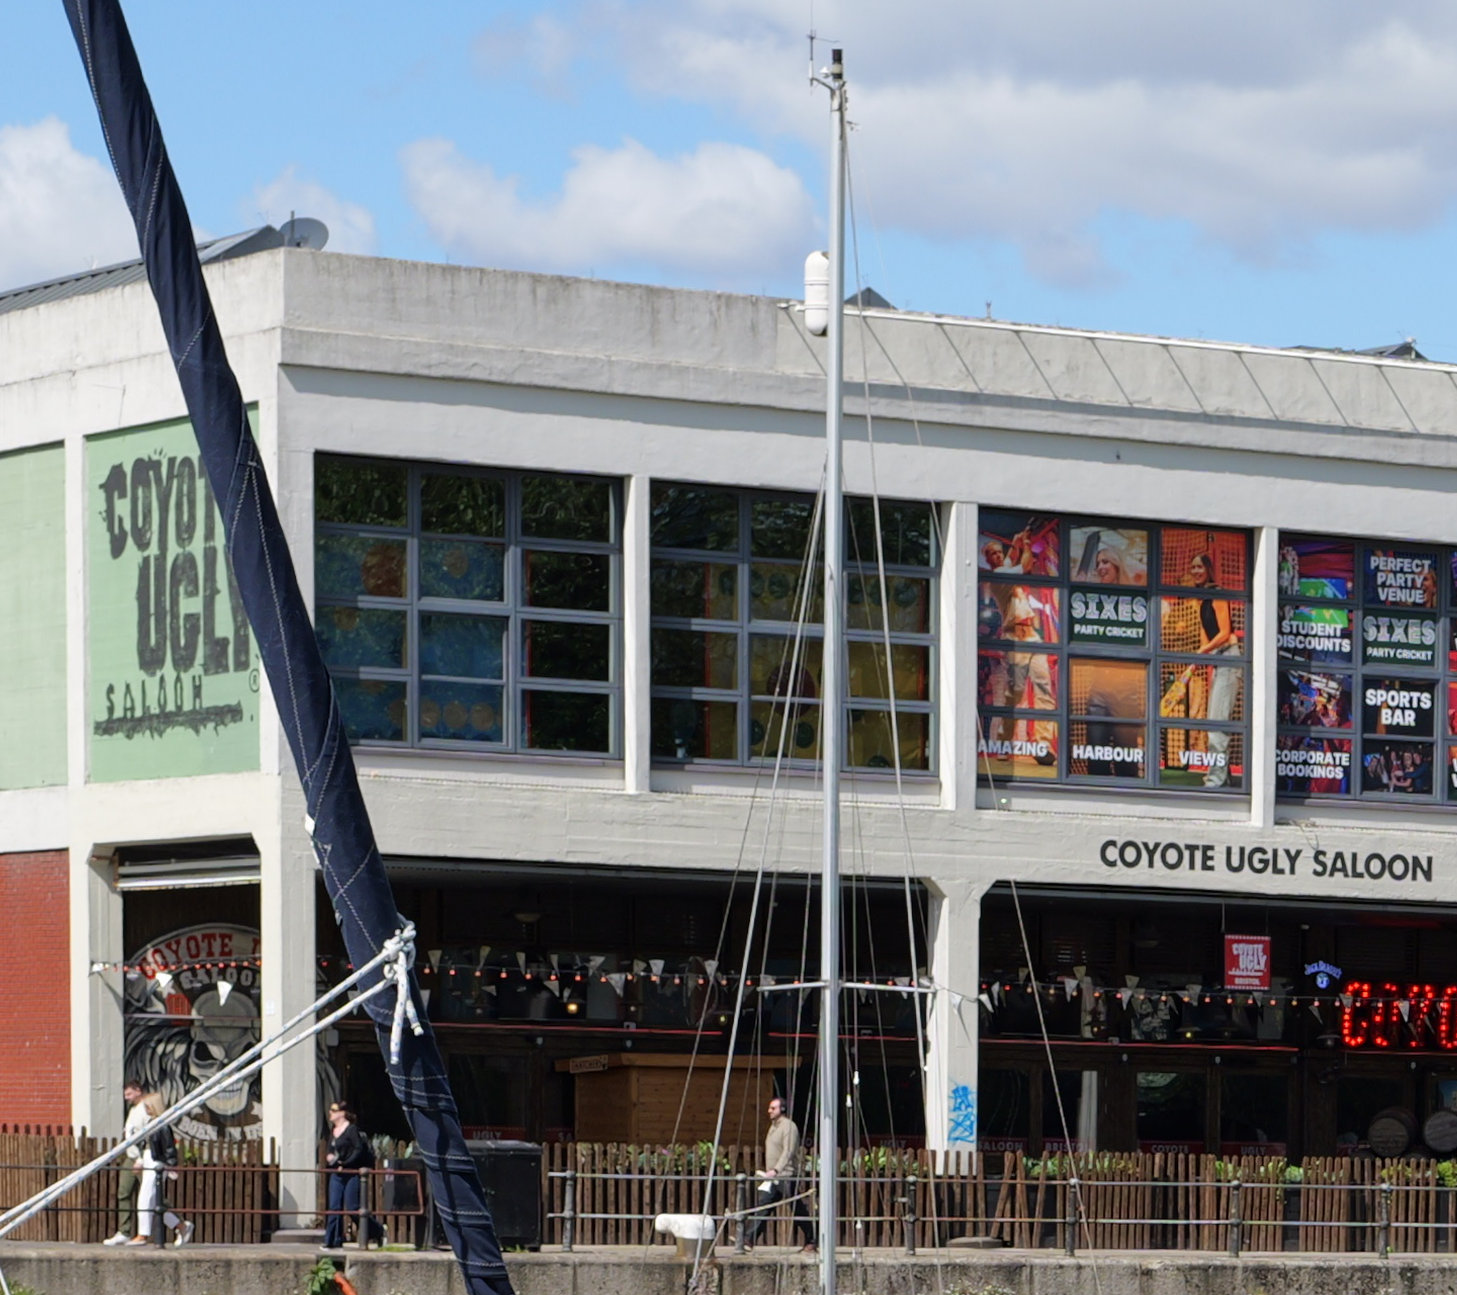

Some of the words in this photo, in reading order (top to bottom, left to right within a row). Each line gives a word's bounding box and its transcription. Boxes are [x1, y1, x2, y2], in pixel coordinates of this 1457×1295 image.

[99, 456, 216, 560] COYOT
[1370, 556, 1431, 573] PERFECT
[1377, 572, 1424, 587] PARTY
[1378, 586, 1424, 604] VENUE
[1070, 591, 1147, 623] SIXES
[1074, 623, 1104, 636] PARTY
[1105, 625, 1144, 638] CRICKET
[1281, 620, 1344, 637] STUDENT
[1363, 615, 1436, 645] SIXES
[1277, 635, 1351, 653] DISCOUNTS
[1367, 646, 1395, 658] PARTY
[1396, 648, 1433, 661] CRICKET
[1365, 688, 1432, 709] SPORTS
[1380, 708, 1416, 727] BAR
[978, 739, 1048, 757] AMAZING
[1073, 744, 1144, 763] HARBOUR
[1179, 750, 1226, 767] VIEWS
[1276, 749, 1350, 766] CORPORATE
[1277, 763, 1344, 780] BOOKINGS
[1099, 840, 1215, 871] COYOTE
[1225, 845, 1303, 875] UGLY
[1312, 850, 1433, 882] SALOON
[139, 932, 234, 980] COYOTE
[179, 966, 260, 990] SALOO
